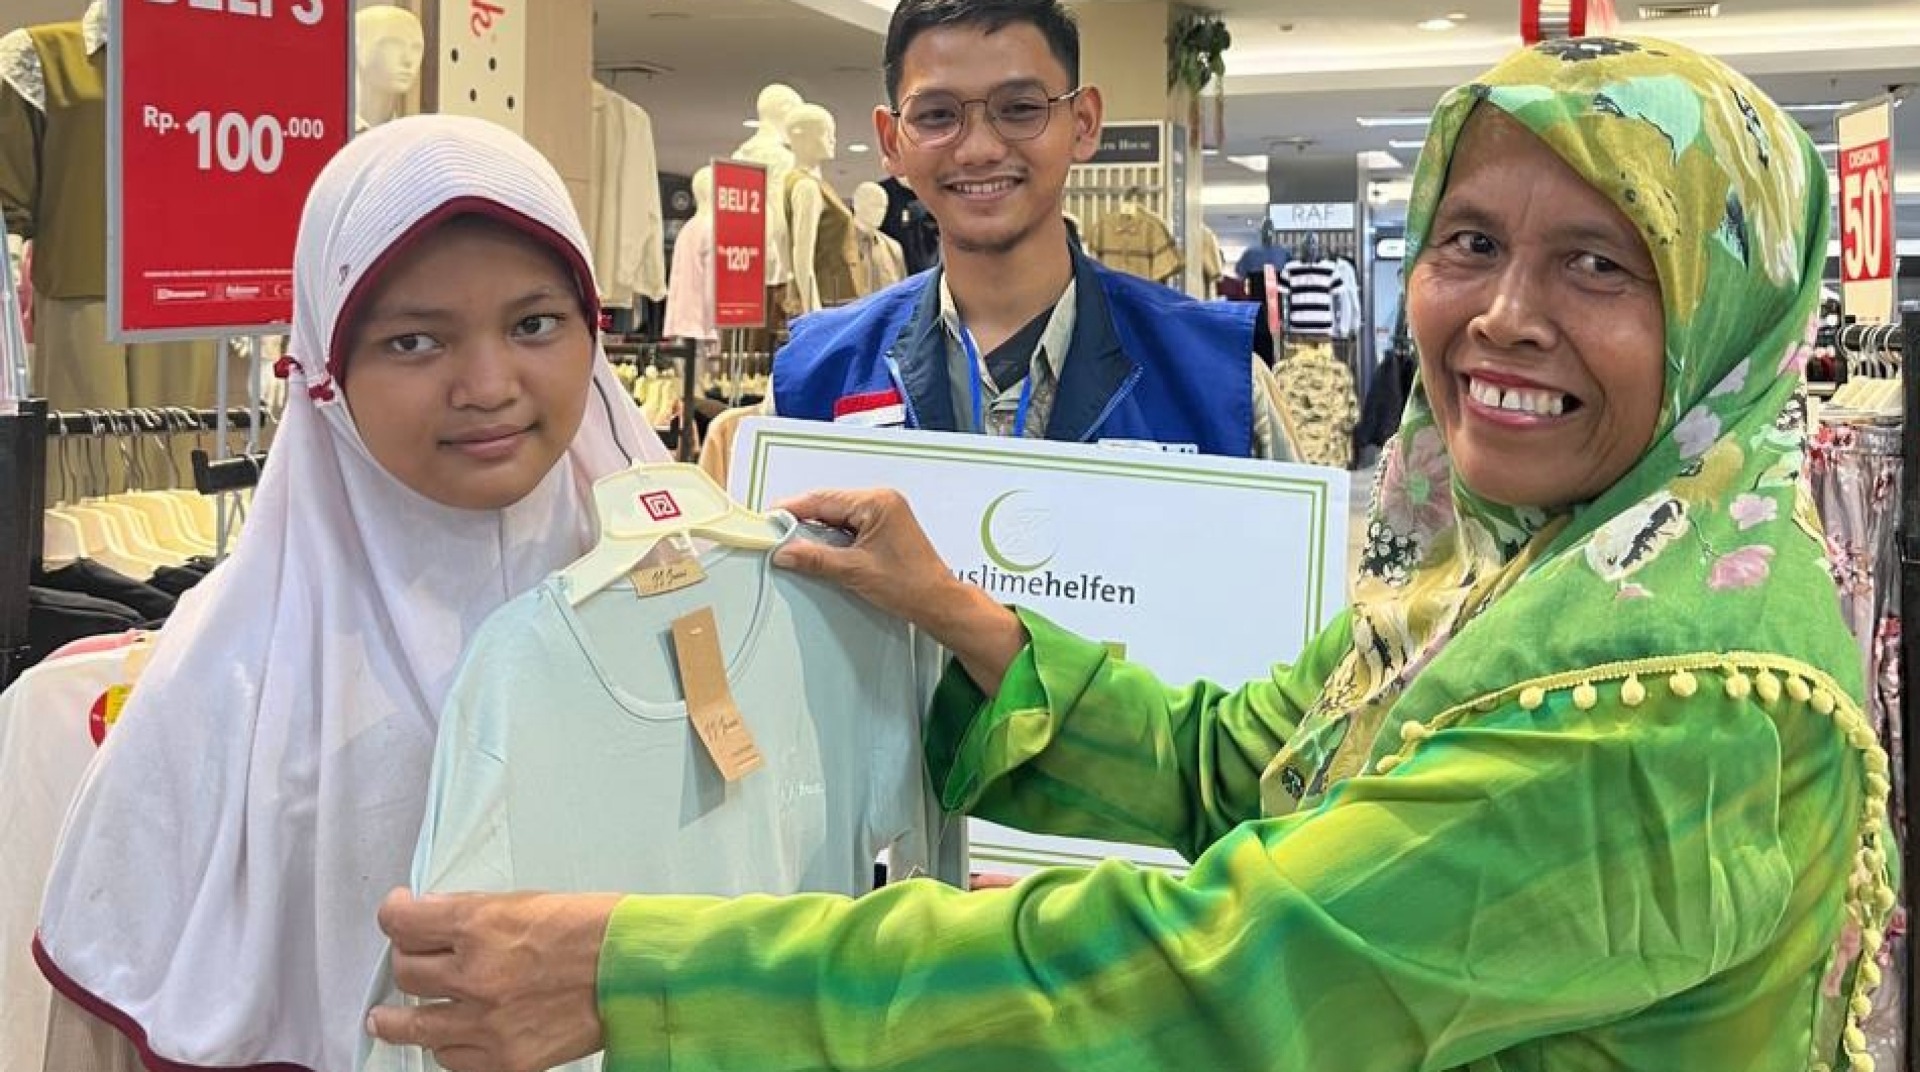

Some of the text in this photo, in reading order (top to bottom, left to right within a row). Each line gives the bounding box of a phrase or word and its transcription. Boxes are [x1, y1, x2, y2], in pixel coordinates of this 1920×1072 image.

[143, 104, 181, 135] Rp.
[718, 186, 760, 215] BELI 2
[949, 564, 1137, 604] slimehelfen
